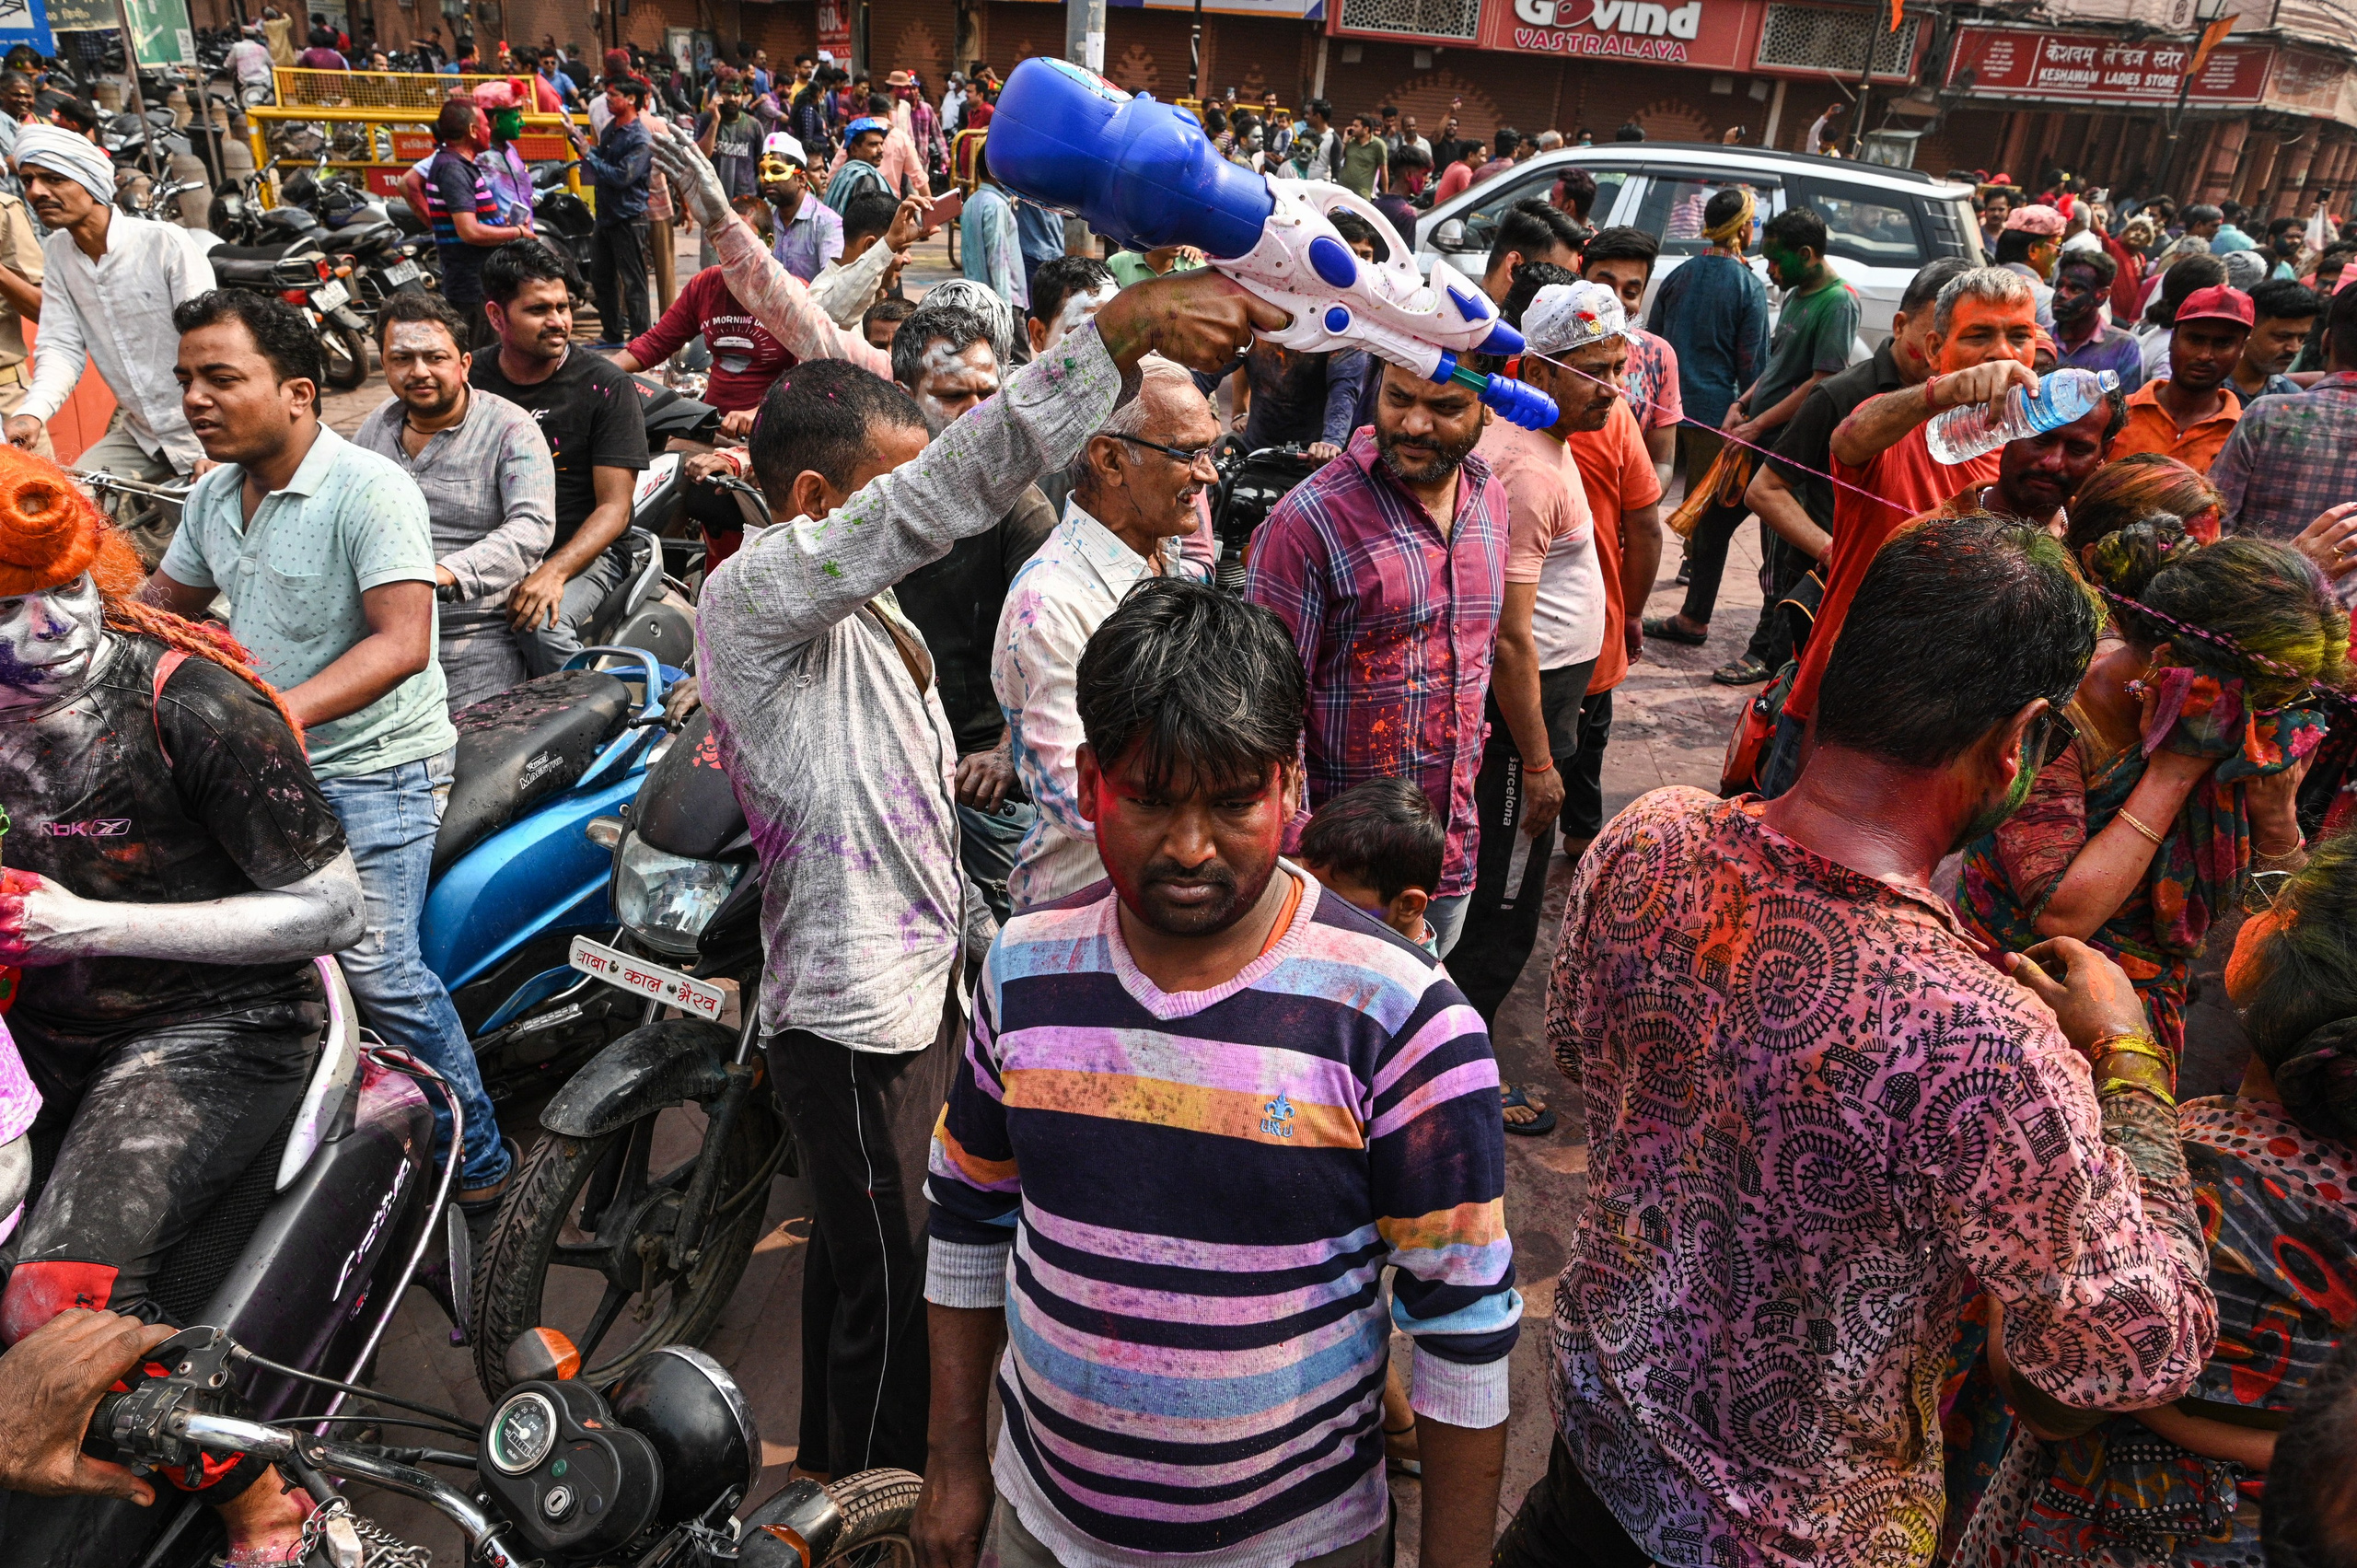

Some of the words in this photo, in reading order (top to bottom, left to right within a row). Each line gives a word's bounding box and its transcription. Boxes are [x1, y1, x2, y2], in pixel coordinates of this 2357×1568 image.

[1515, 28, 1687, 62] VASTRALAYA
[2104, 71, 2142, 86] LADIES
[2144, 74, 2179, 87] STORE
[712, 315, 753, 326] MORNING
[519, 756, 564, 790] MAESTRO
[623, 968, 664, 993] काल
[677, 981, 718, 1013] भैरव
[528, 1421, 539, 1431] TVS
